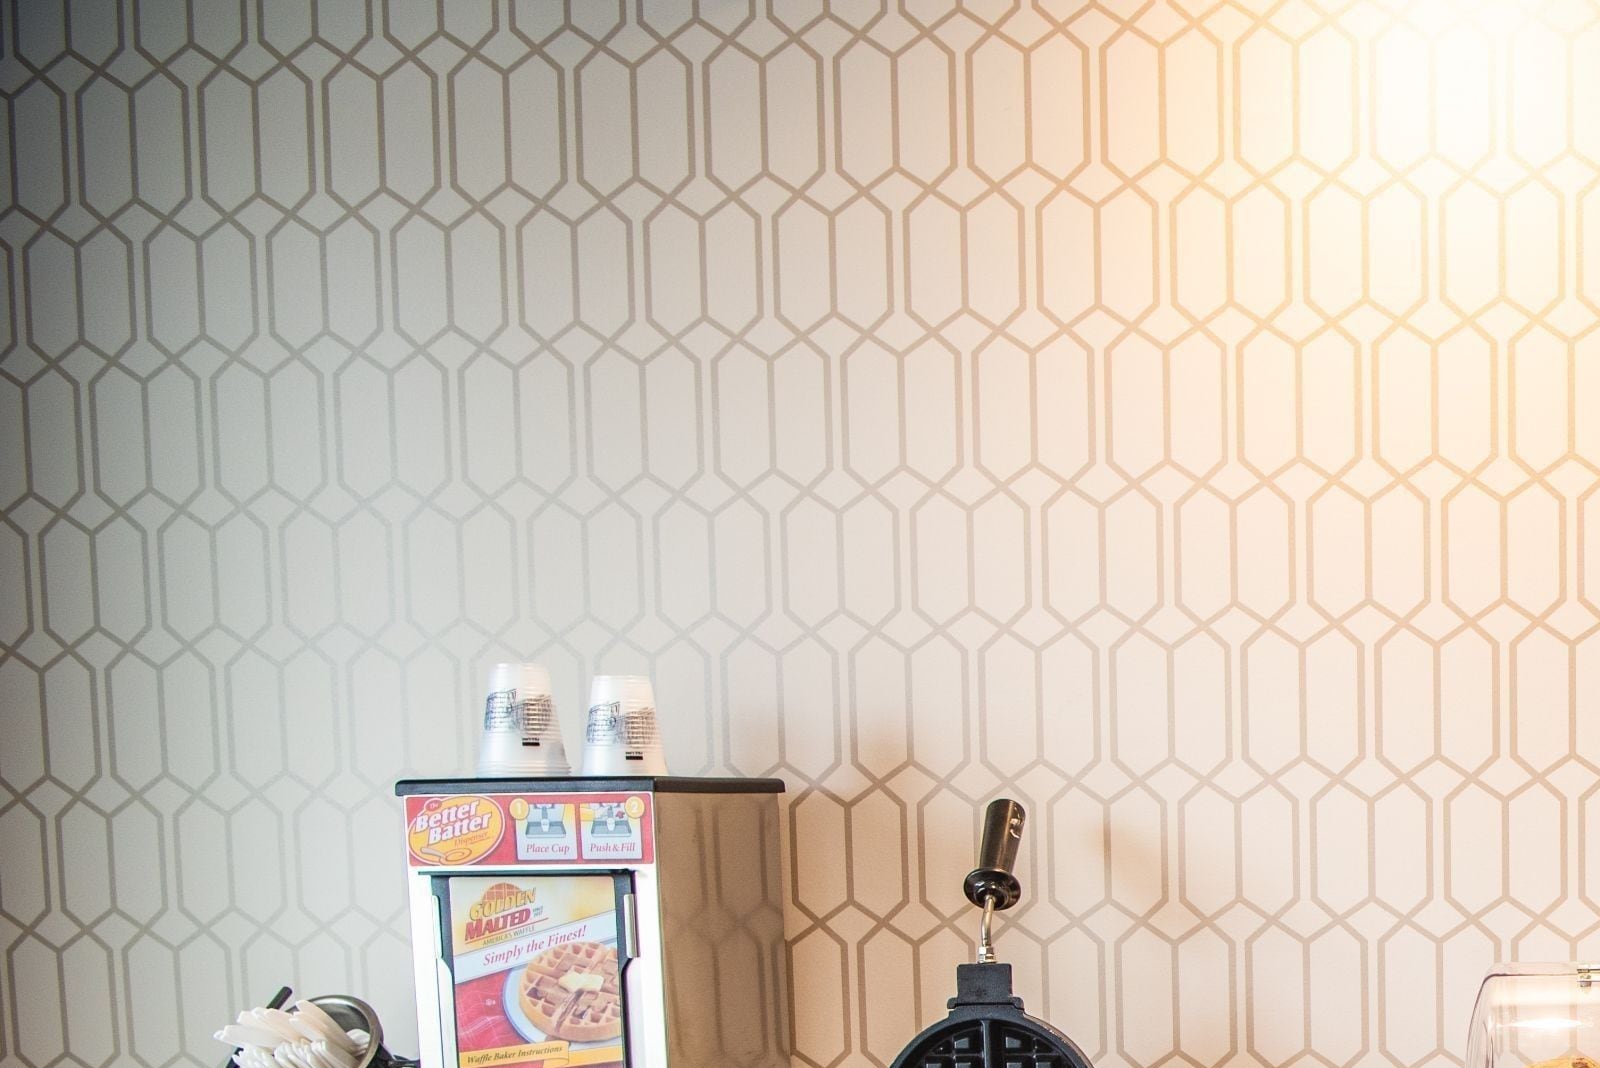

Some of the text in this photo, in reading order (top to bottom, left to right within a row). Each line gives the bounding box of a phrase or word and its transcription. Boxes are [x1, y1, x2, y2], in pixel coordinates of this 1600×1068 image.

[414, 800, 480, 833] Better
[429, 802, 439, 810] The
[631, 800, 639, 815] 2
[427, 812, 492, 846] Batter
[526, 843, 570, 855] Place Cup
[590, 842, 636, 852] Push & Fill
[469, 887, 537, 921] GOLDEN
[465, 908, 532, 941] MALTED
[482, 925, 535, 948] AMERICA'S WAFFLE
[482, 924, 587, 966] Simply the Finest!
[467, 1045, 564, 1065] Waffle Baker Instructions
